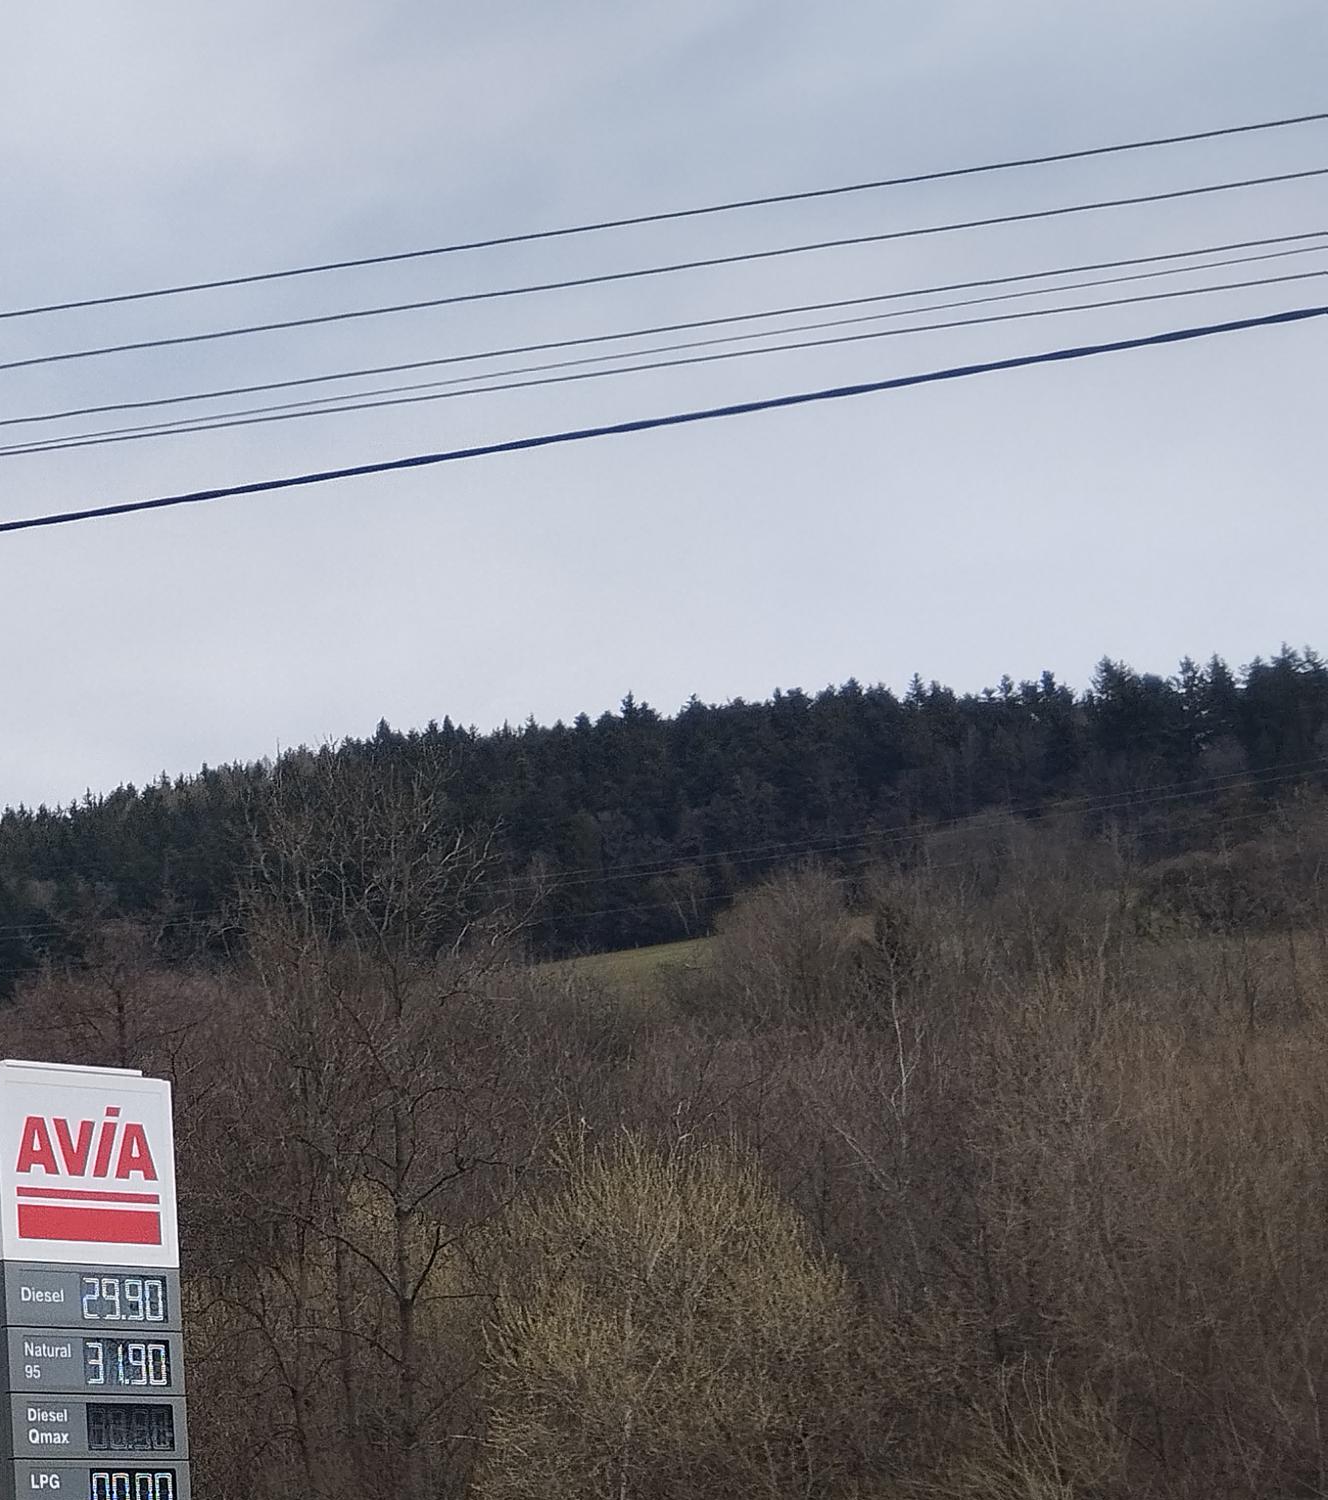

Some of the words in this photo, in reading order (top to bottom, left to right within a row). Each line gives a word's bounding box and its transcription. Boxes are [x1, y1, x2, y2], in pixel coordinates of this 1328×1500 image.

[20, 1286, 64, 1303] Diesel
[82, 1277, 164, 1321] 29.90
[24, 1341, 72, 1358] Natural
[25, 1364, 41, 1379] 95
[85, 1342, 167, 1386] 31.90
[27, 1407, 68, 1422] Diesel
[28, 1428, 70, 1444] Qmax
[30, 1473, 60, 1489] LPG
